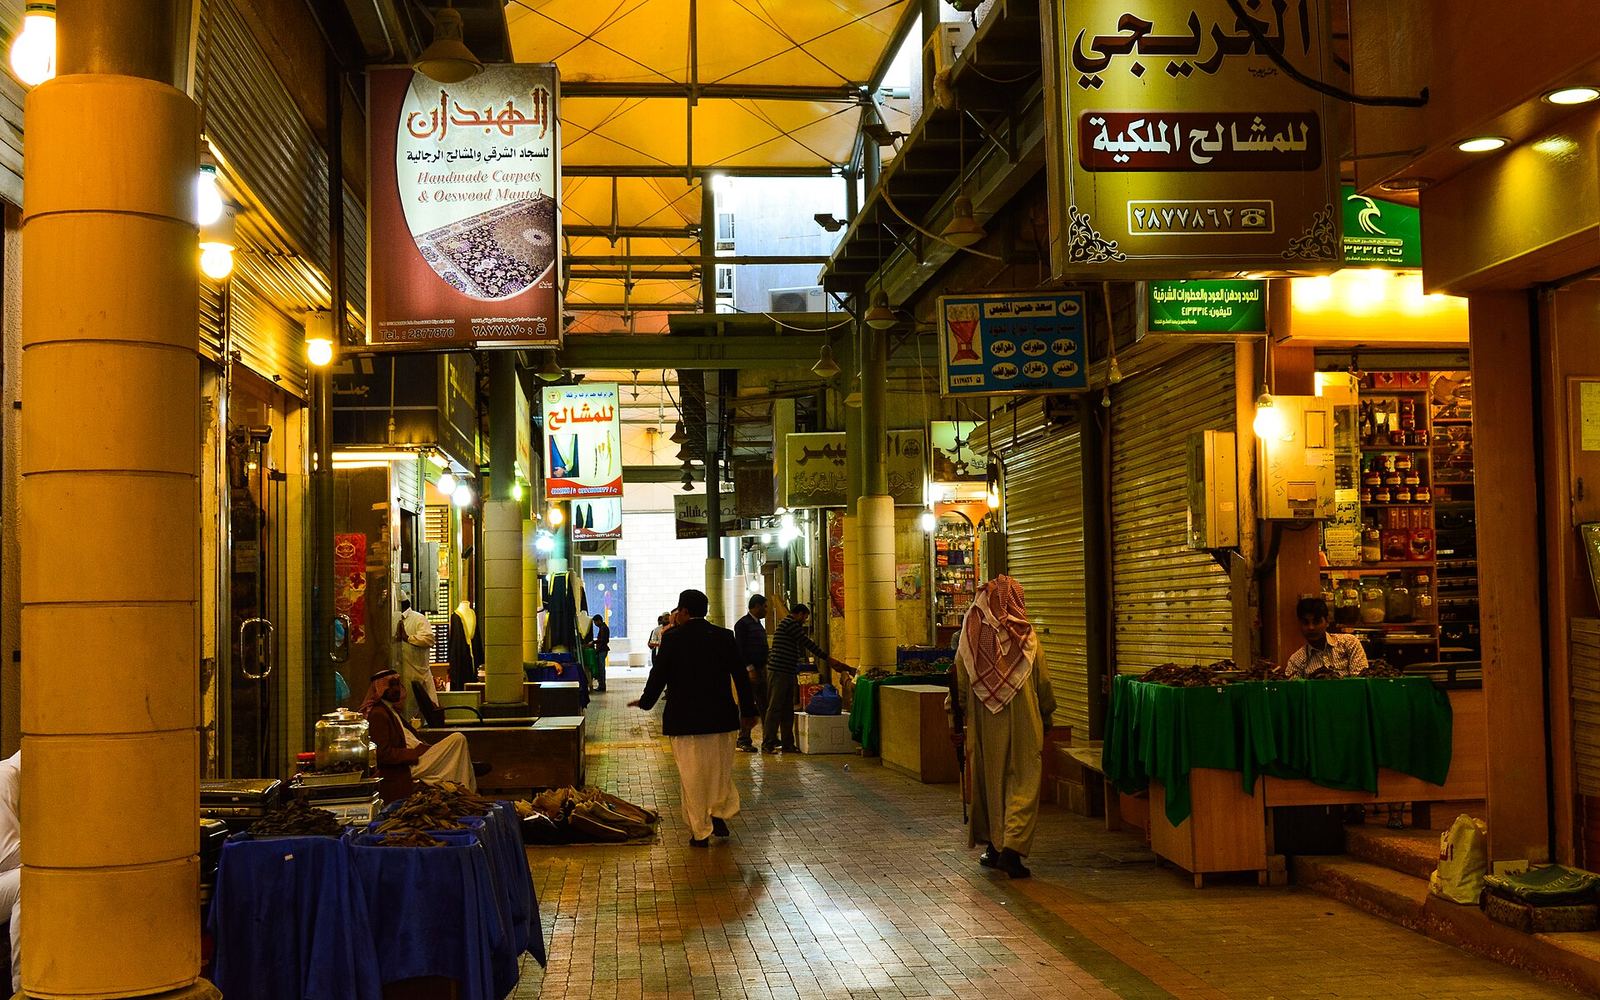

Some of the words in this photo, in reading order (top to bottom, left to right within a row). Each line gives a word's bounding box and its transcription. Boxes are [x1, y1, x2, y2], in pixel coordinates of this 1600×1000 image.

[406, 87, 550, 141] الهبدان
[1089, 116, 1181, 164] الملكية
[1188, 116, 1309, 165] للمشالح
[406, 149, 444, 163] الرجالية
[446, 147, 481, 163] والمشالح
[483, 146, 516, 163] الشرقي
[519, 147, 550, 161] للسجاد
[417, 170, 488, 184] Handmade
[492, 170, 542, 185] Carpets
[417, 190, 428, 203] &
[1133, 207, 1233, 229] ٢٨٧٧٨٦٢
[1153, 286, 1177, 303] الشرقية
[408, 326, 456, 339] 2877870
[471, 324, 526, 337] ٢٨٧٧٨٧٠
[548, 402, 614, 431] للمشالح
